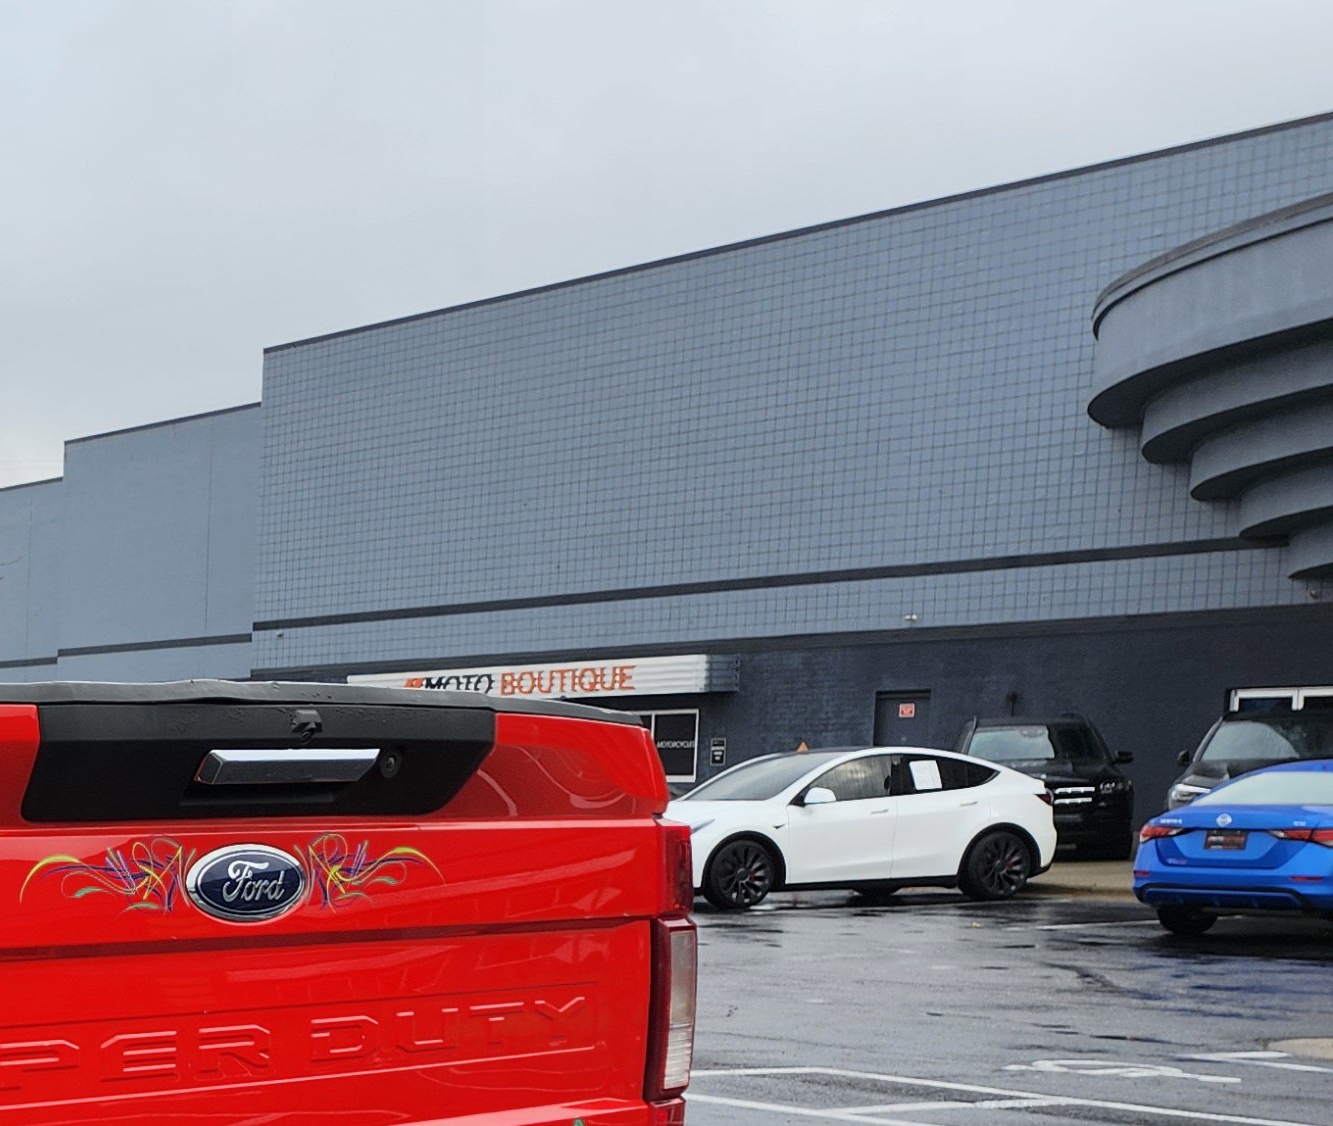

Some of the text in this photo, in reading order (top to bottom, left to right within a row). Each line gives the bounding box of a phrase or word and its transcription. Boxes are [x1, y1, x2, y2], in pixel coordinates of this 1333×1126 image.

[423, 665, 637, 696] MOTO BOUTIQUE
[221, 859, 285, 902] Ford
[307, 994, 587, 1064] DUTY
